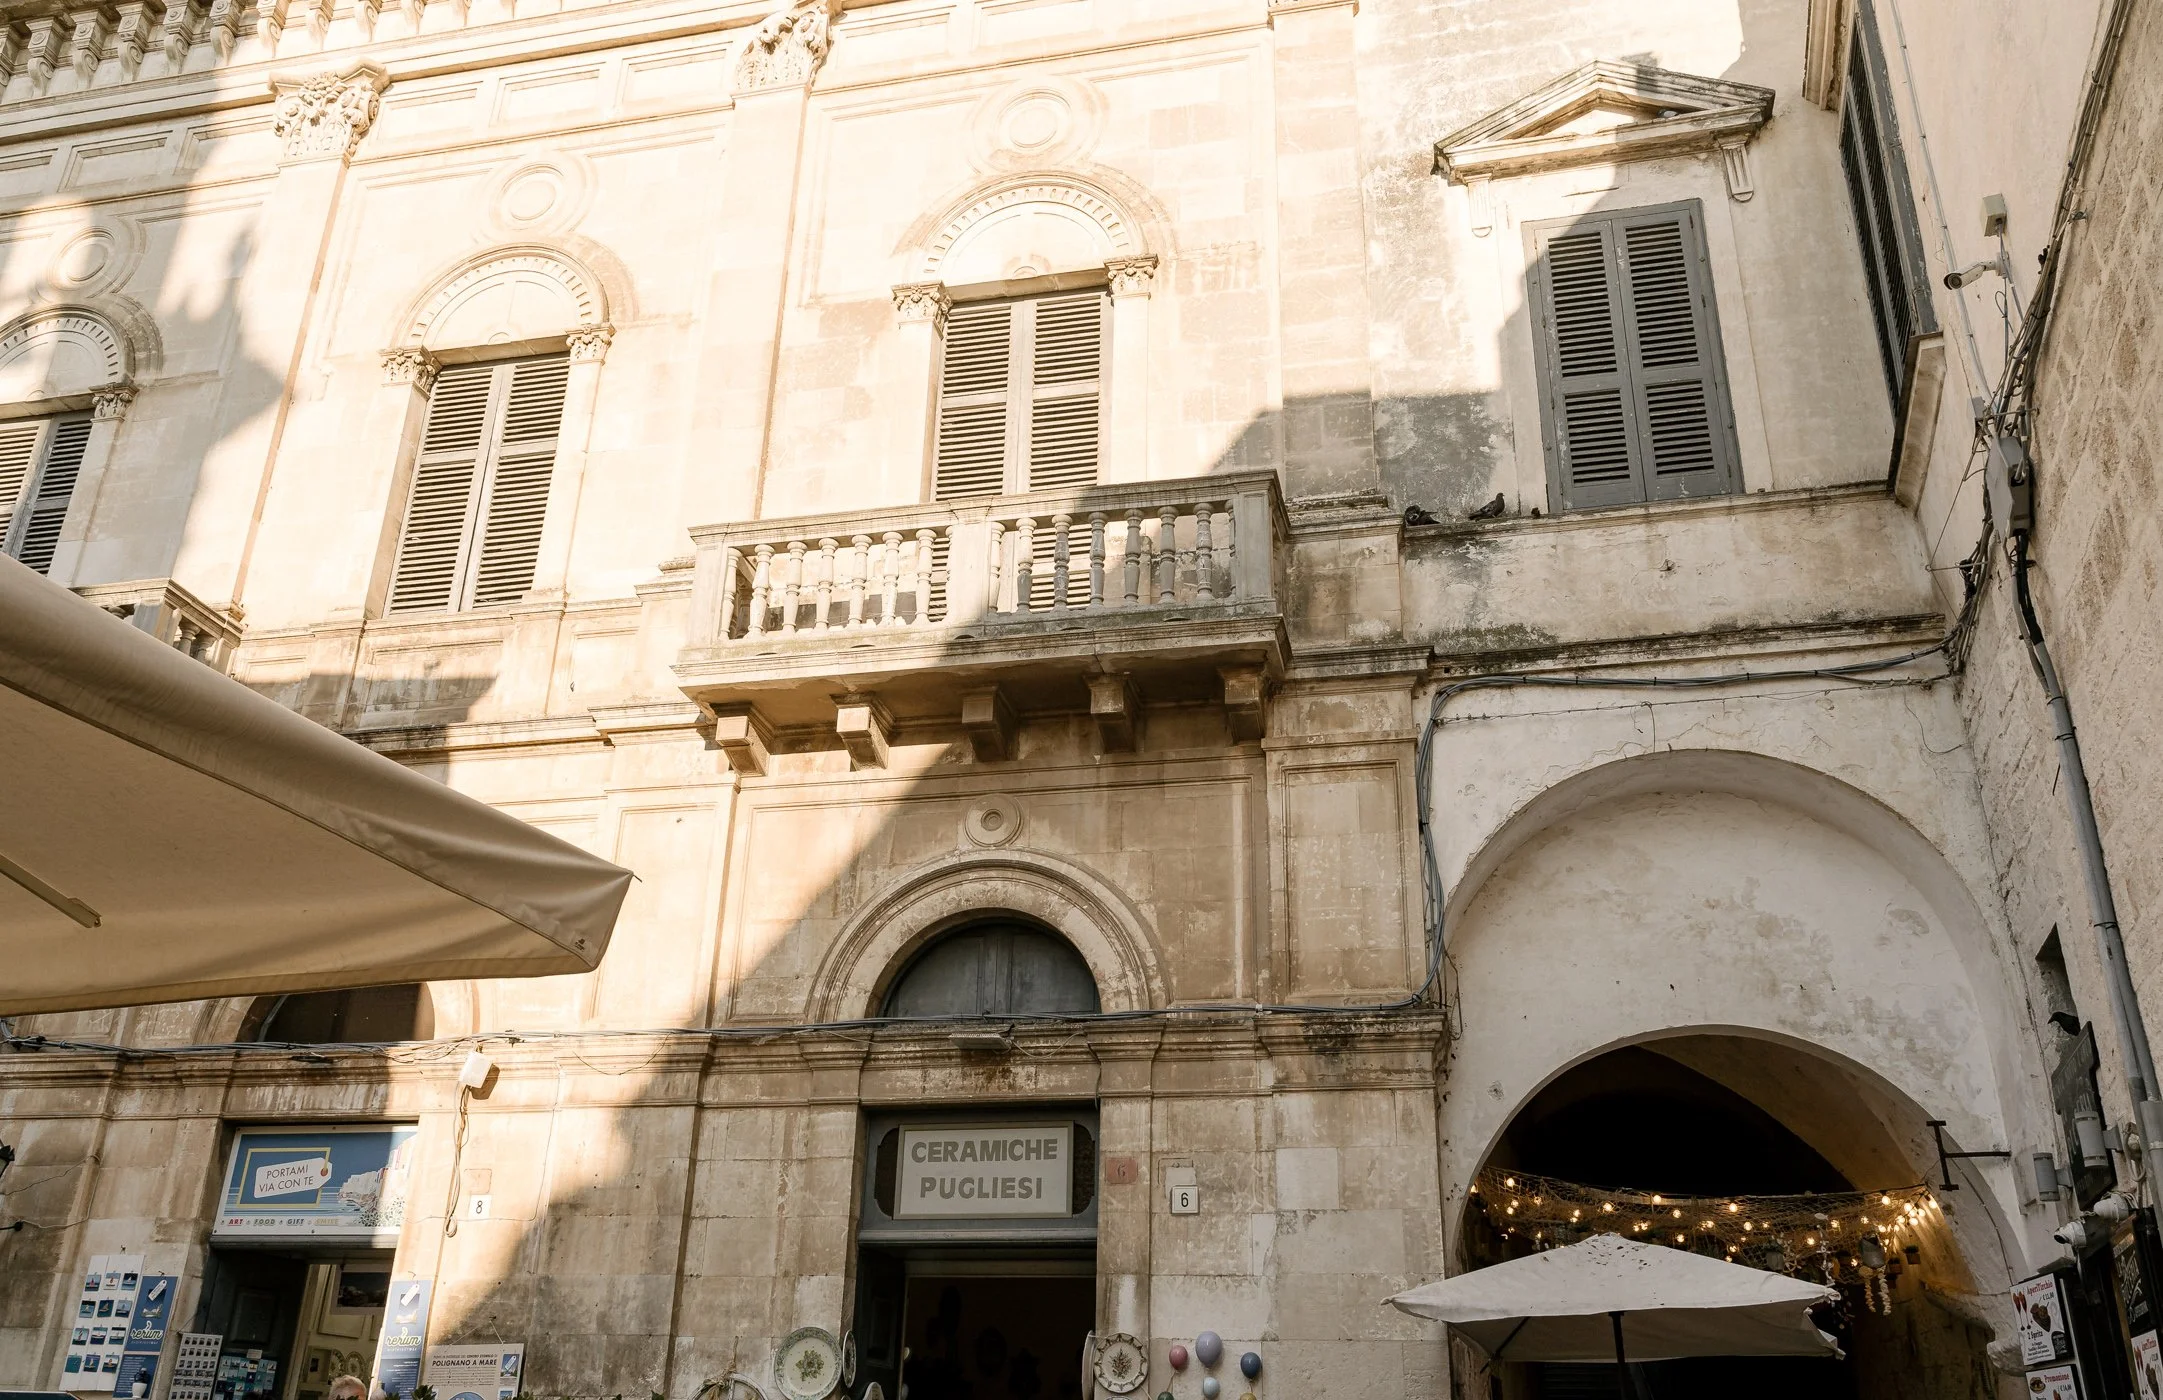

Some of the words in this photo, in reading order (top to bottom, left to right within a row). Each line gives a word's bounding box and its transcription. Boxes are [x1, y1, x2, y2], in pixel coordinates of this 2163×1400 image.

[911, 1138, 1058, 1163] CERAMICHE
[266, 1164, 309, 1179] PORTAMI
[259, 1182, 275, 1193] VIA
[277, 1179, 301, 1190] CON
[303, 1175, 314, 1186] TE
[920, 1176, 1042, 1200] PUGLIESI
[475, 1200, 483, 1215] 8
[1180, 1192, 1189, 1208] 6
[228, 1218, 244, 1226] ART
[253, 1218, 276, 1226] FOOD
[286, 1218, 305, 1226] GIFT
[130, 1323, 163, 1340] rerum
[386, 1329, 422, 1346] rerum
